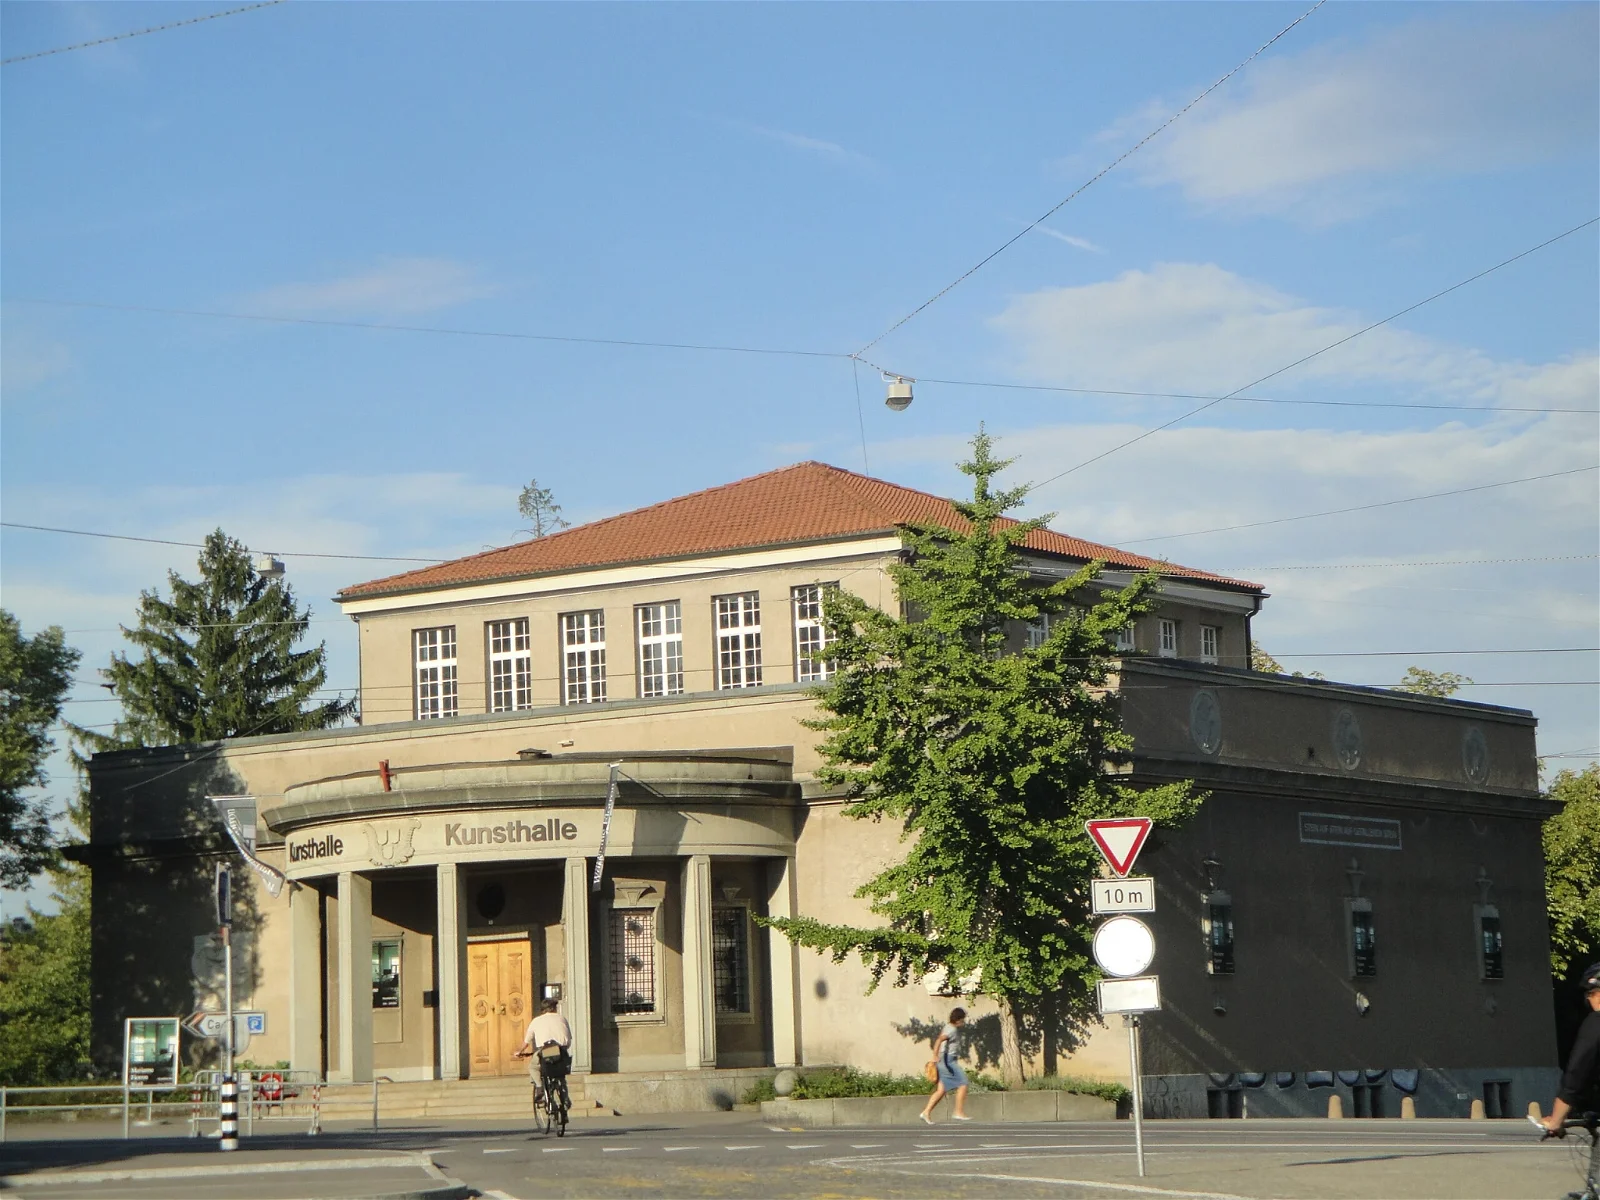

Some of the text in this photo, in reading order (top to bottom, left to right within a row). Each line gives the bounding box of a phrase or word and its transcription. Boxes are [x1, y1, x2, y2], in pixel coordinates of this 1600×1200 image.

[445, 818, 578, 846] Kunsthalle
[289, 834, 344, 863] Kunsthalle
[1104, 888, 1143, 904] 10 m
